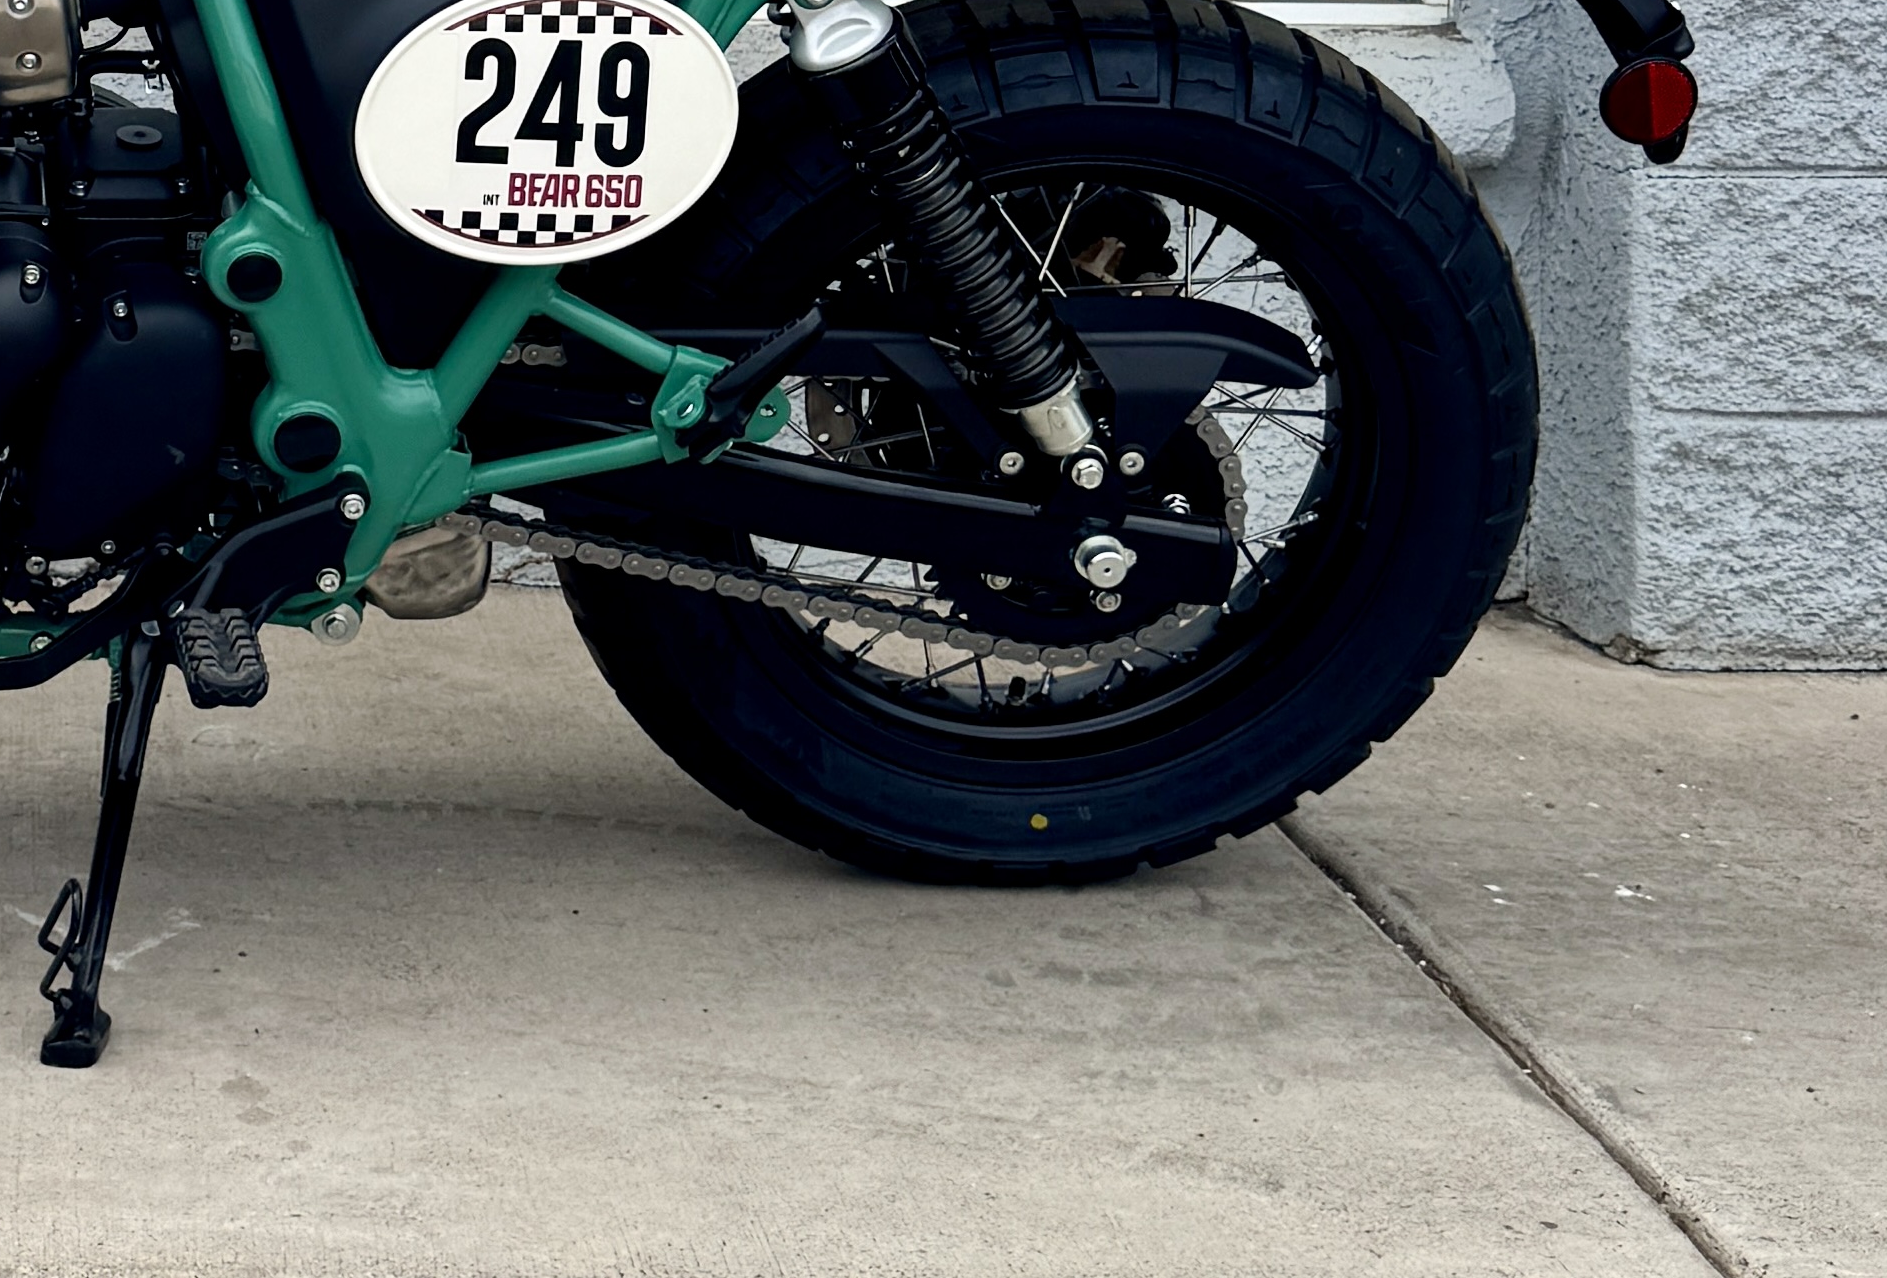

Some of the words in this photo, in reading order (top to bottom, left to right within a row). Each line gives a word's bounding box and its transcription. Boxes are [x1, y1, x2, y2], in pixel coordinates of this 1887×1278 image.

[455, 37, 651, 168] 249
[482, 193, 502, 206] INT
[507, 172, 581, 209] BEAR
[584, 174, 643, 209] 650
